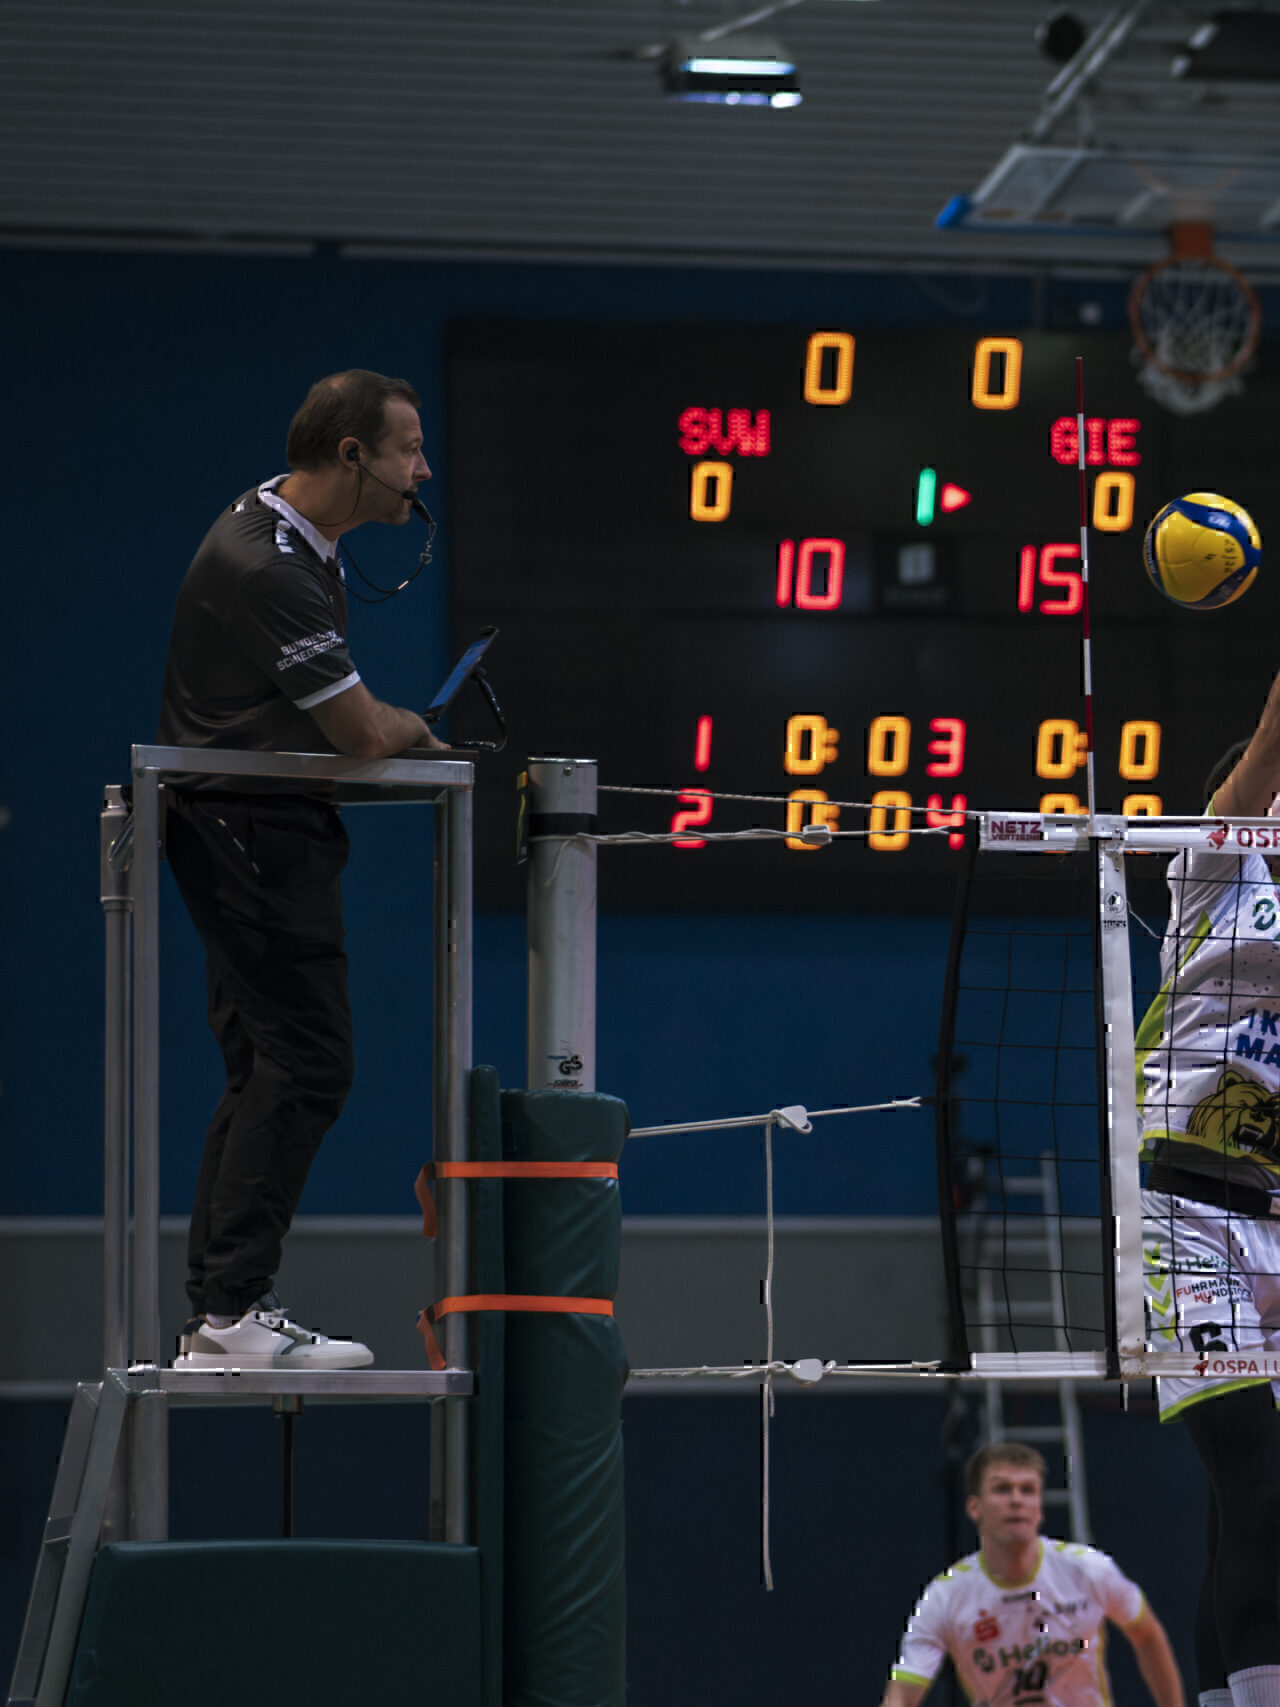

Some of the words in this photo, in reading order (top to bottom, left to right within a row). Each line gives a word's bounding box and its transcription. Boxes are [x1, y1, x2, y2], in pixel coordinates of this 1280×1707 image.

[804, 331, 856, 406] 0
[971, 337, 1023, 411] 0
[690, 461, 734, 522] 0
[1092, 471, 1136, 532] 0
[776, 537, 846, 611] 10
[1017, 542, 1085, 616] 15
[694, 714, 713, 772] 1
[925, 717, 967, 778] 3
[991, 820, 1042, 834] NETZ
[1213, 1360, 1260, 1375] OSPA
